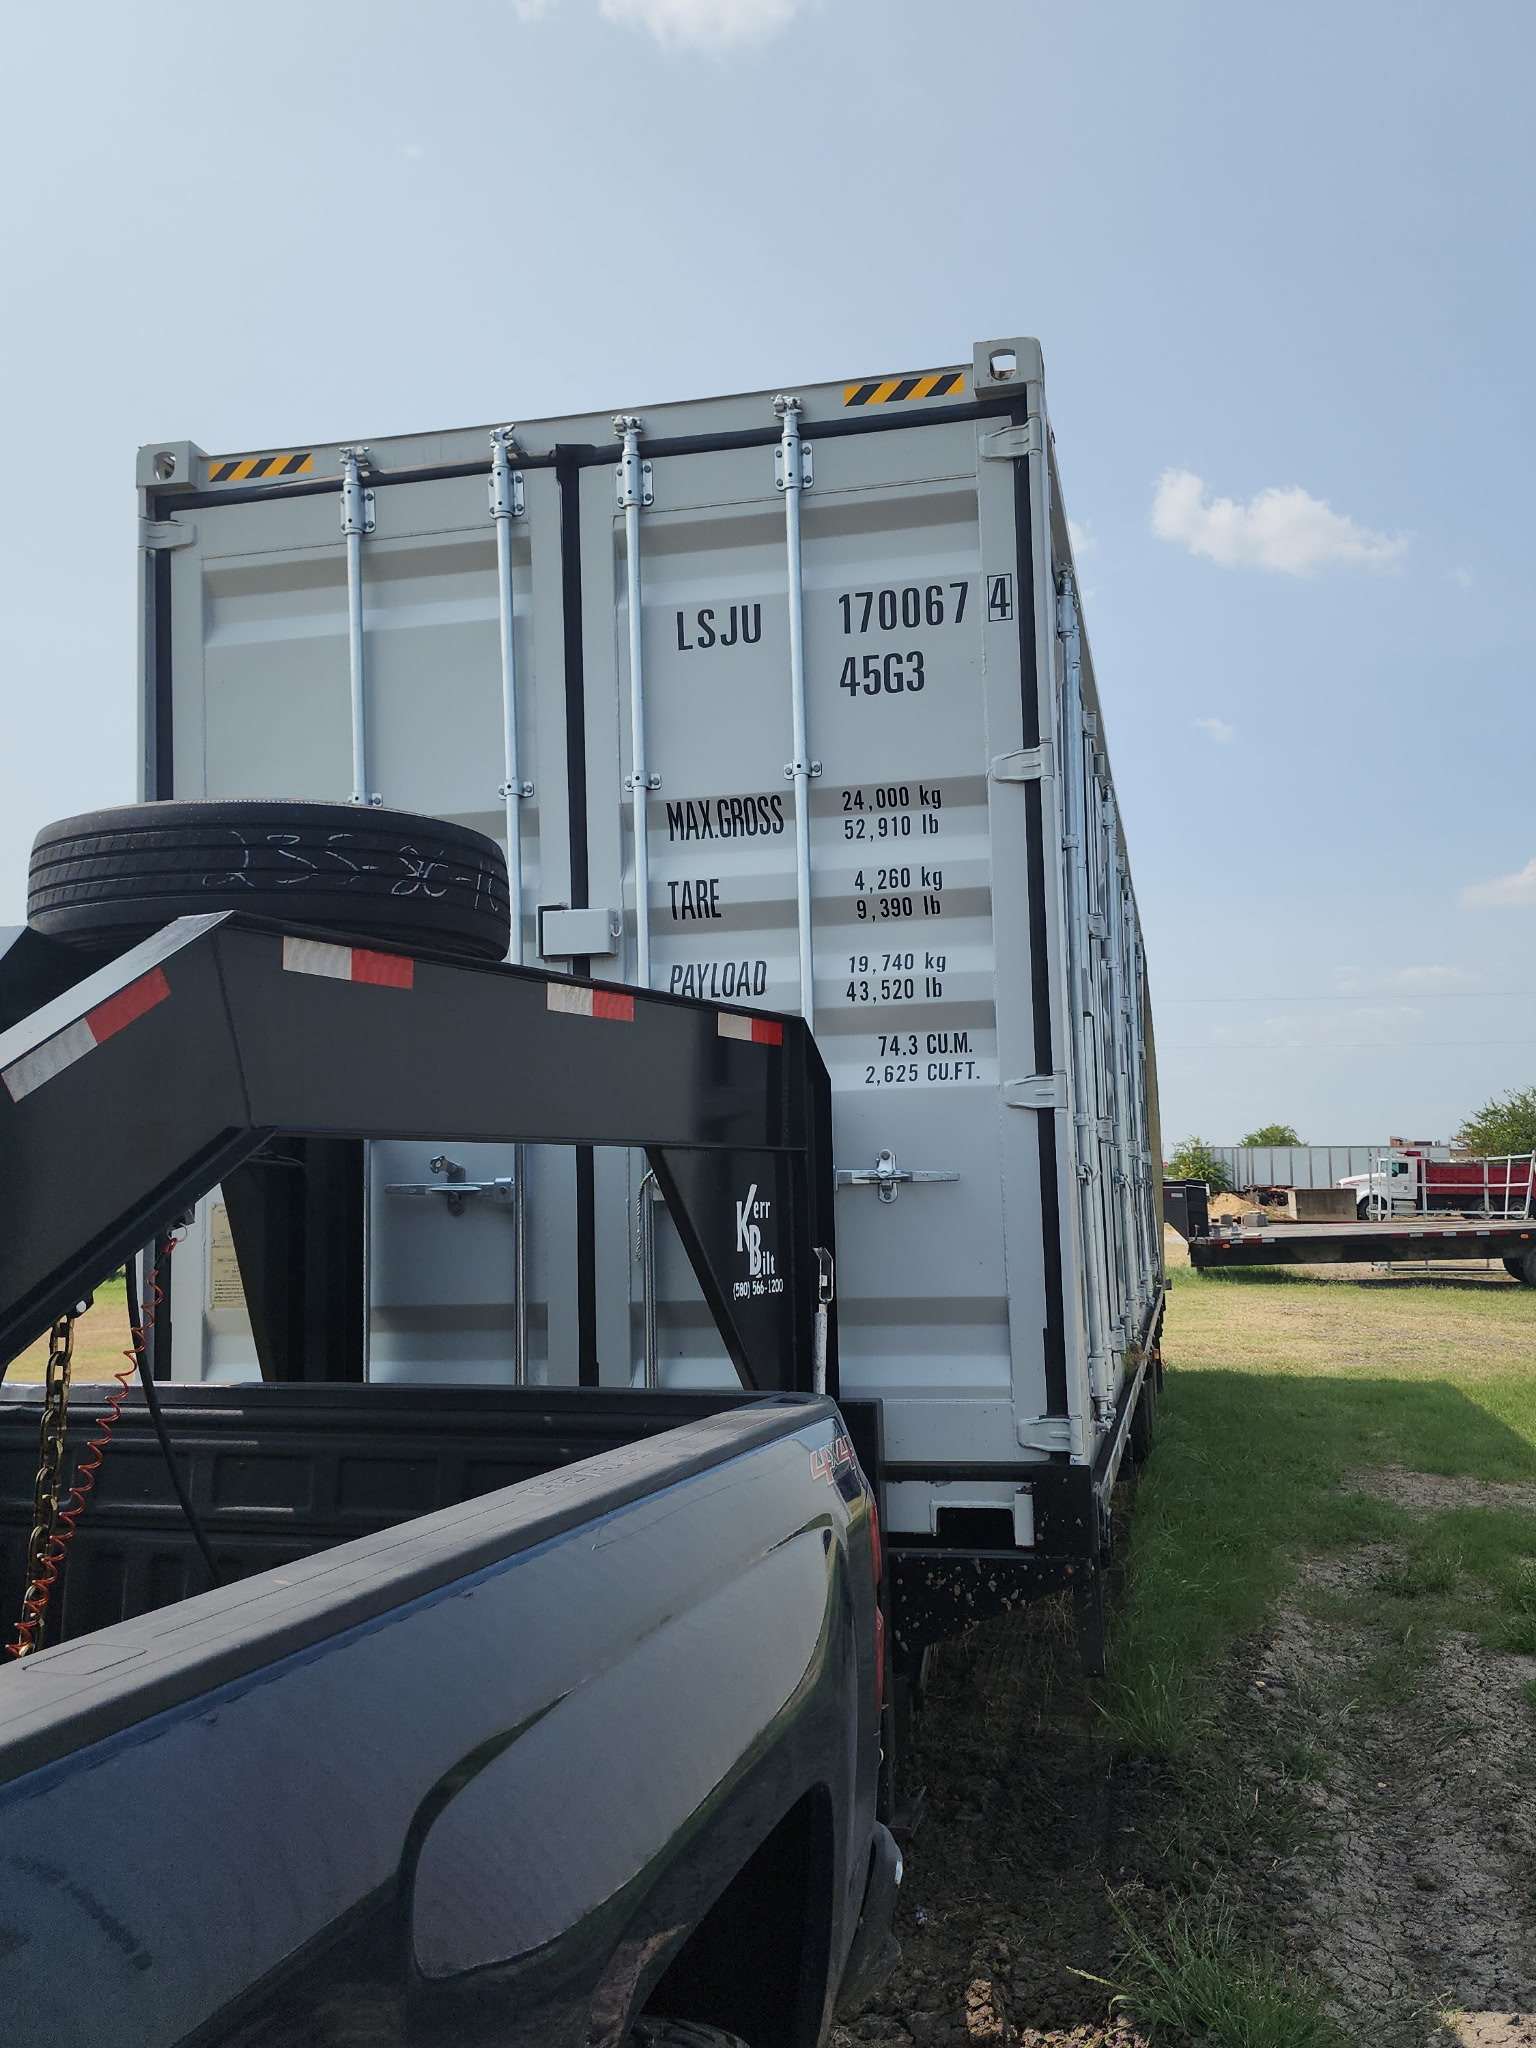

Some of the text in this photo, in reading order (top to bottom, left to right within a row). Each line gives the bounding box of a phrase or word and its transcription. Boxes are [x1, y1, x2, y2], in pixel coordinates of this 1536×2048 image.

[676, 577, 1011, 650] LSJU 170067 4
[839, 651, 925, 697] 45G3
[666, 785, 942, 841] MAX.GROSS 24,000 kg
[844, 814, 939, 842] 52,910 lb
[668, 867, 943, 921] TARE 4,260 kg
[856, 895, 940, 922] 9,390 lb
[669, 952, 946, 999] PAYLOAD 19,740 kg
[846, 978, 942, 1004] 43,520 lb
[878, 1032, 973, 1057] 74.3 CU.M.
[866, 1061, 980, 1088] 2,625 CU.FT.
[736, 1183, 771, 1252] Kerr
[749, 1224, 776, 1278] Bilt
[733, 1279, 784, 1300] (580) 566-1200
